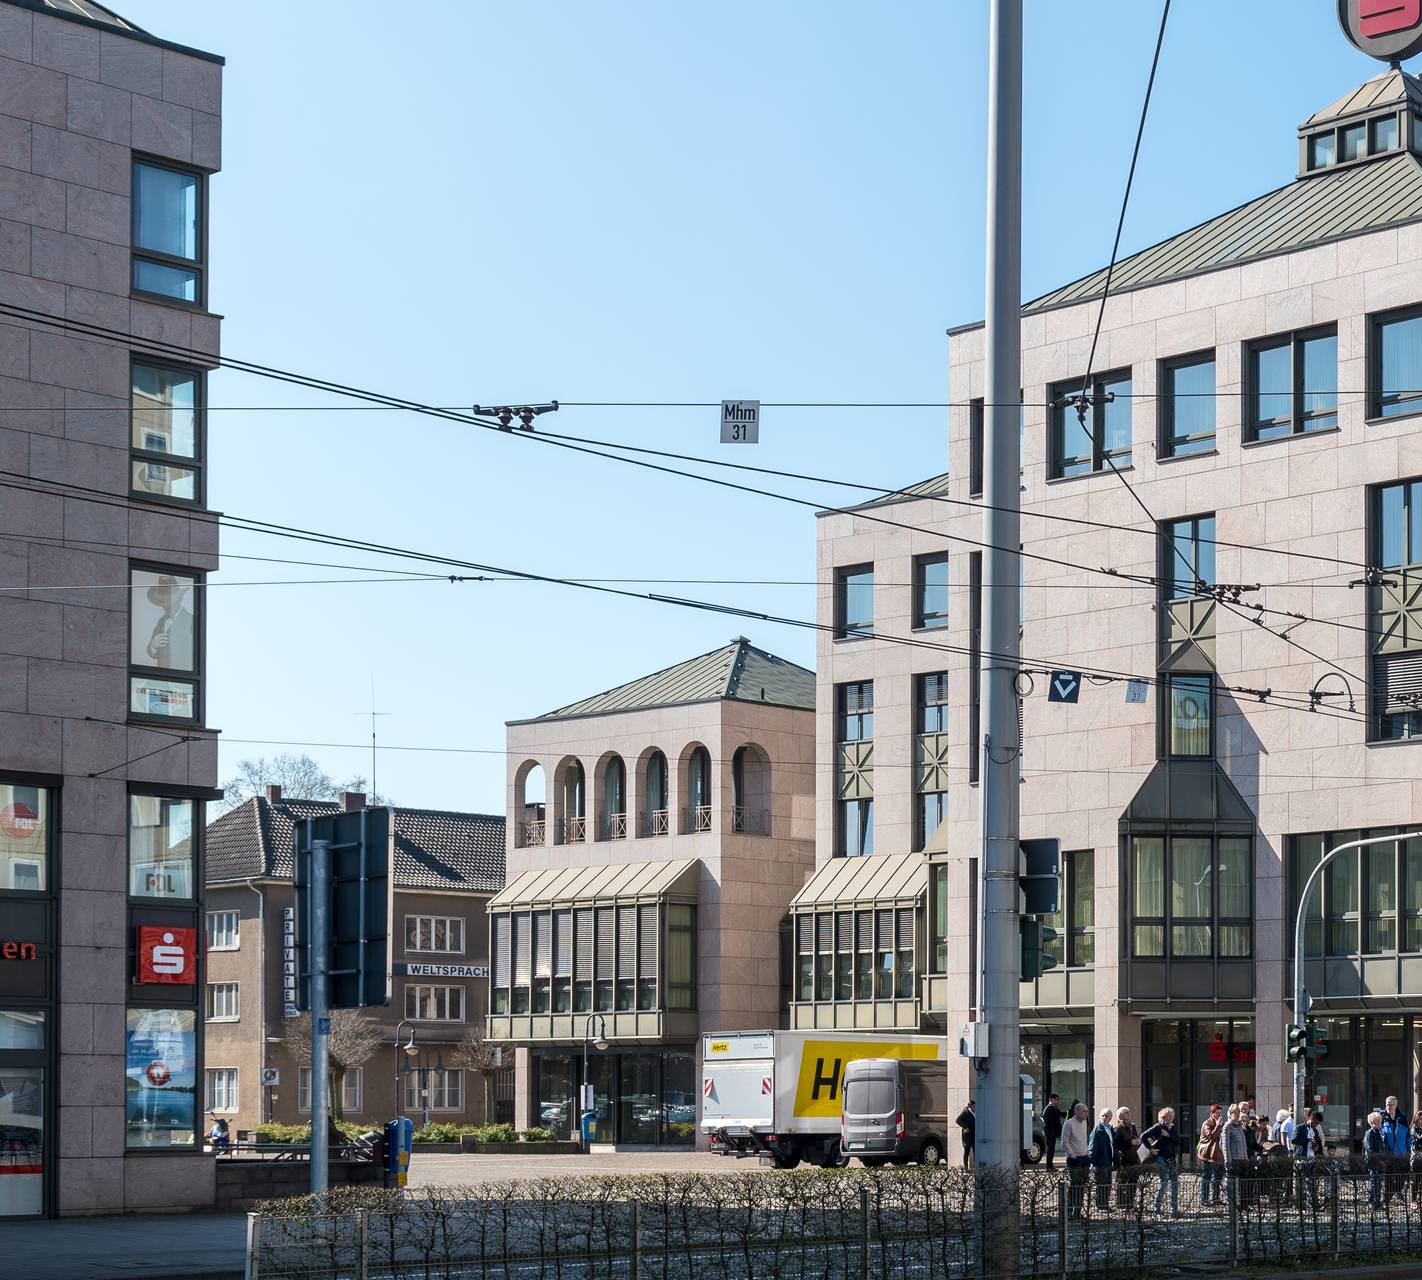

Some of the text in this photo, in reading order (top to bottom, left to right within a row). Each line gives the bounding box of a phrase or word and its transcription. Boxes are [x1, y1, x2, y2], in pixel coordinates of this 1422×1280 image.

[724, 404, 756, 420] Mhm
[732, 424, 747, 440] 31
[2, 940, 37, 960] en
[411, 965, 489, 976] WELTSPRACH
[712, 1043, 727, 1051] Hertz
[811, 1058, 846, 1100] H
